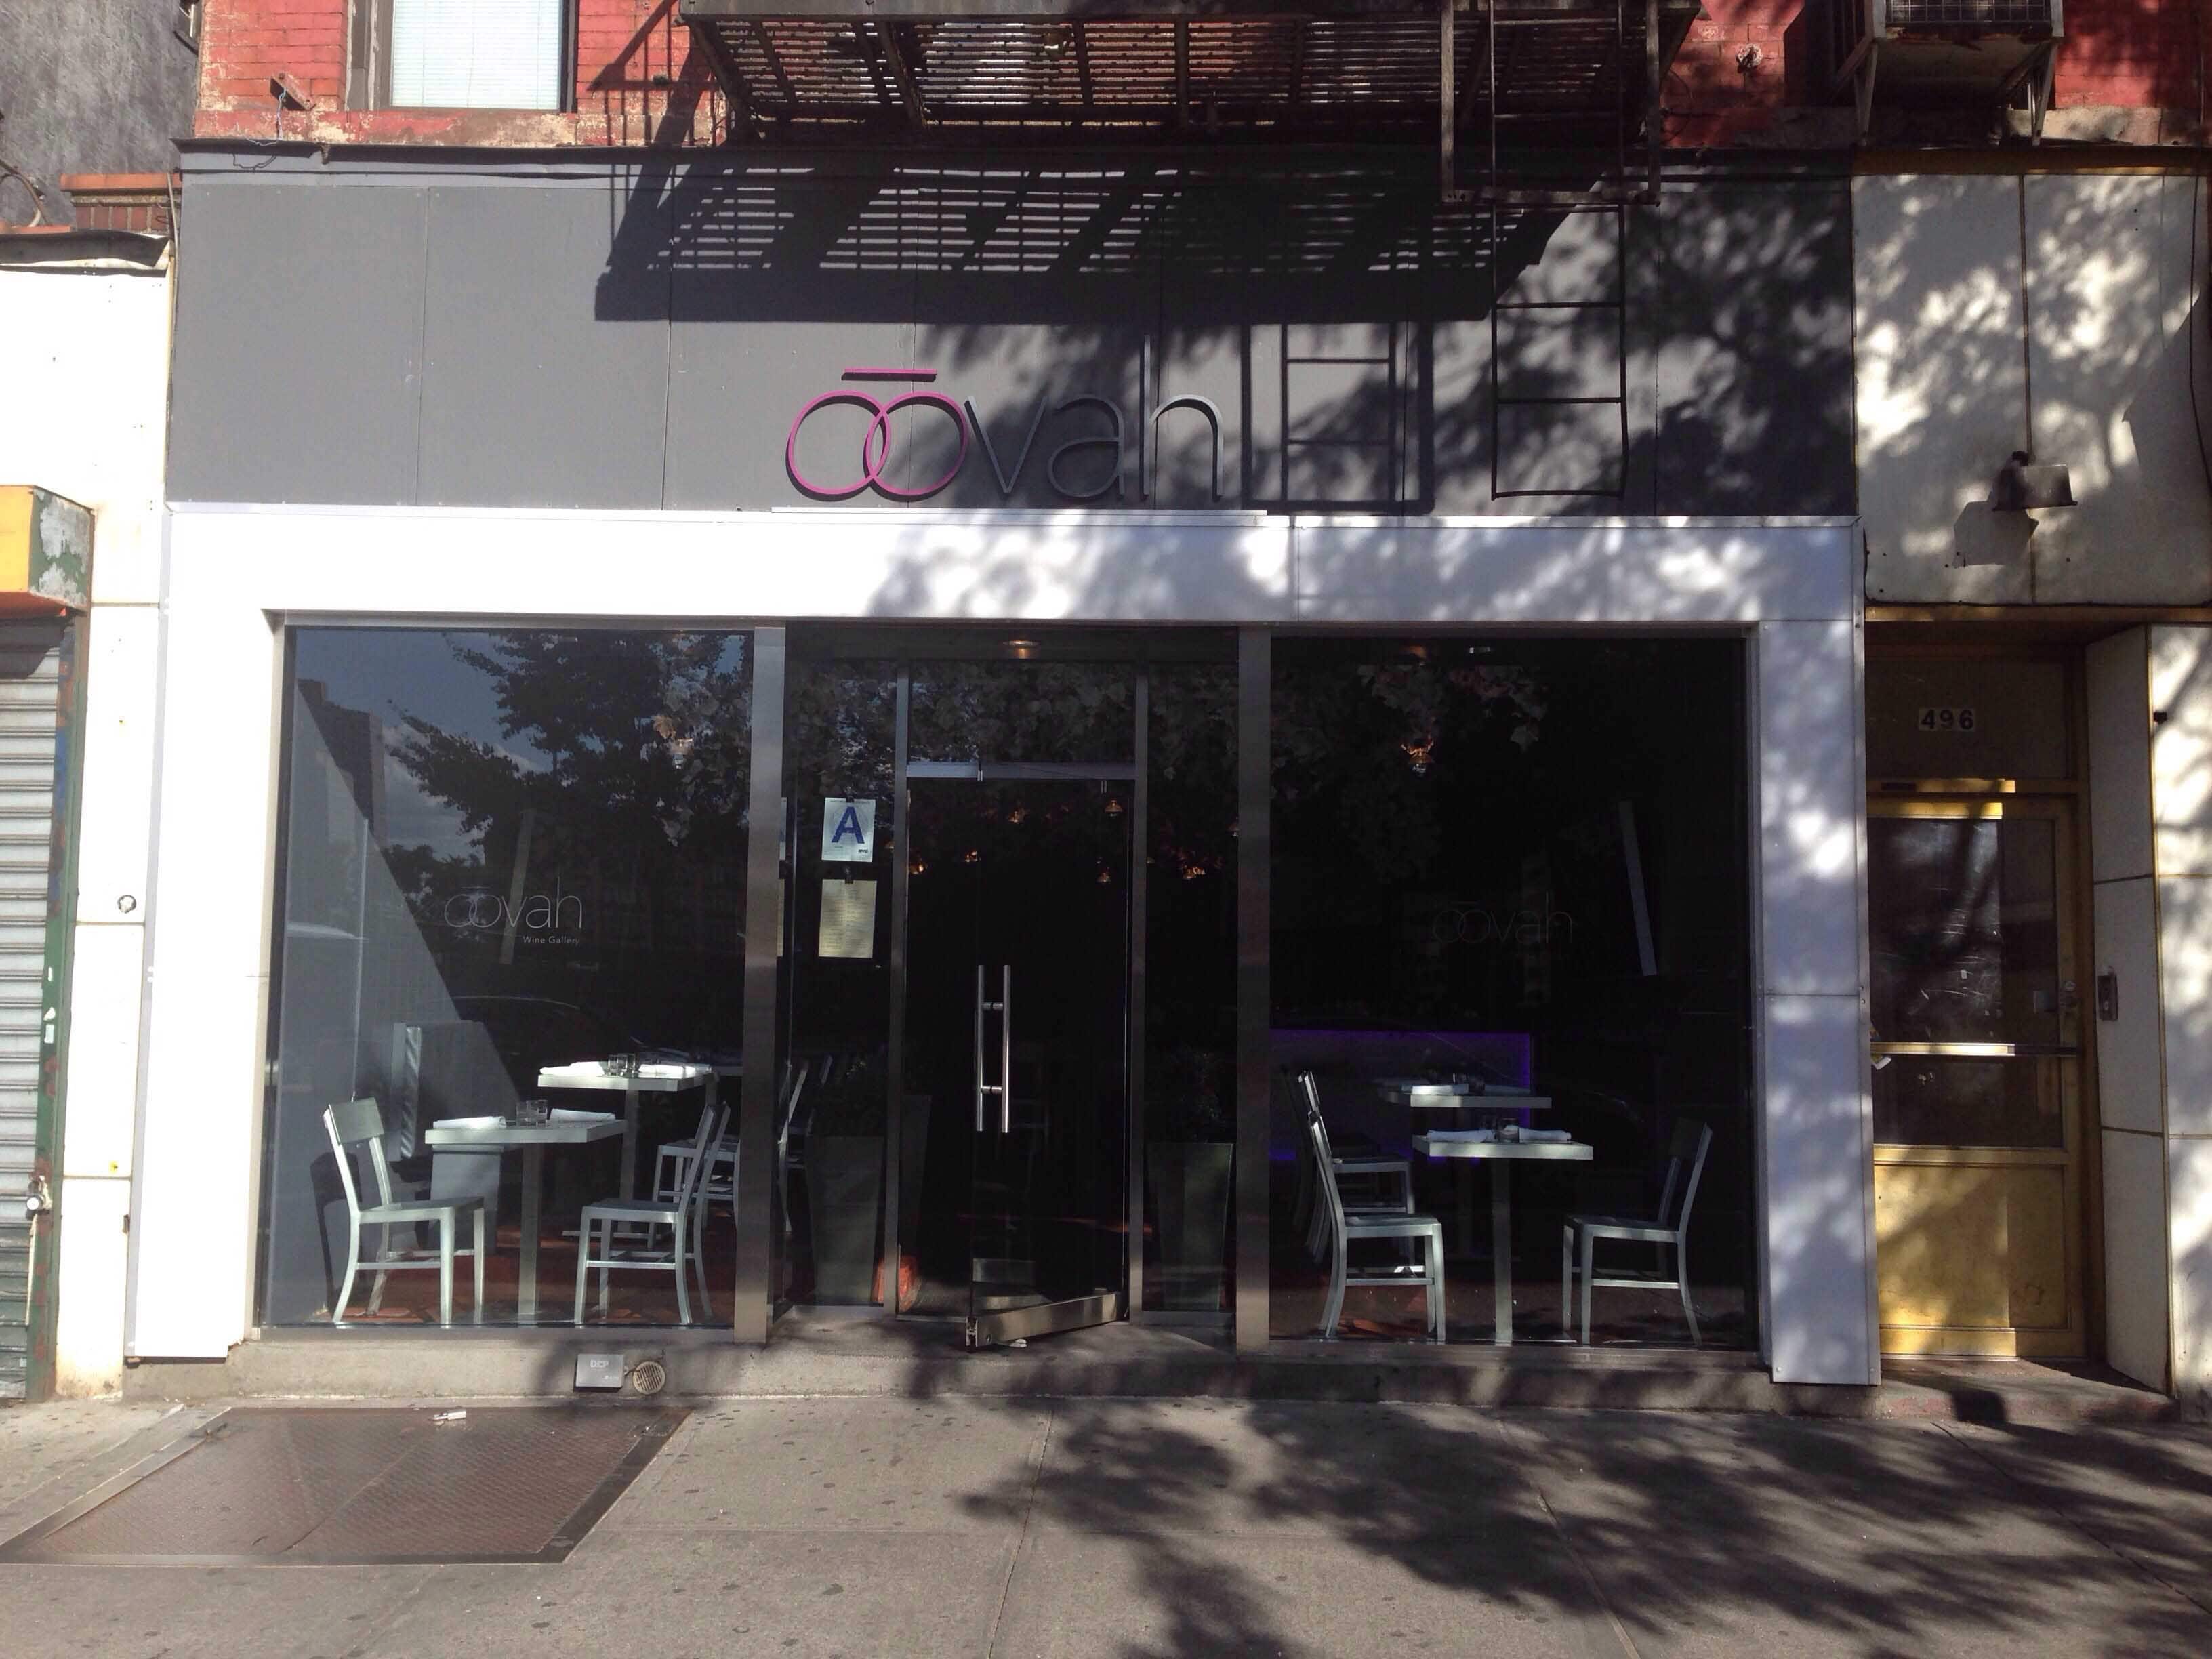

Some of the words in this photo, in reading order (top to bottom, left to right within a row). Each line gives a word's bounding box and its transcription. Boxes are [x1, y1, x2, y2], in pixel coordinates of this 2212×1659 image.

[1921, 709, 1974, 730] 496
[831, 806, 865, 844] A
[523, 935, 545, 944] Wine
[548, 935, 580, 945] Gallery
